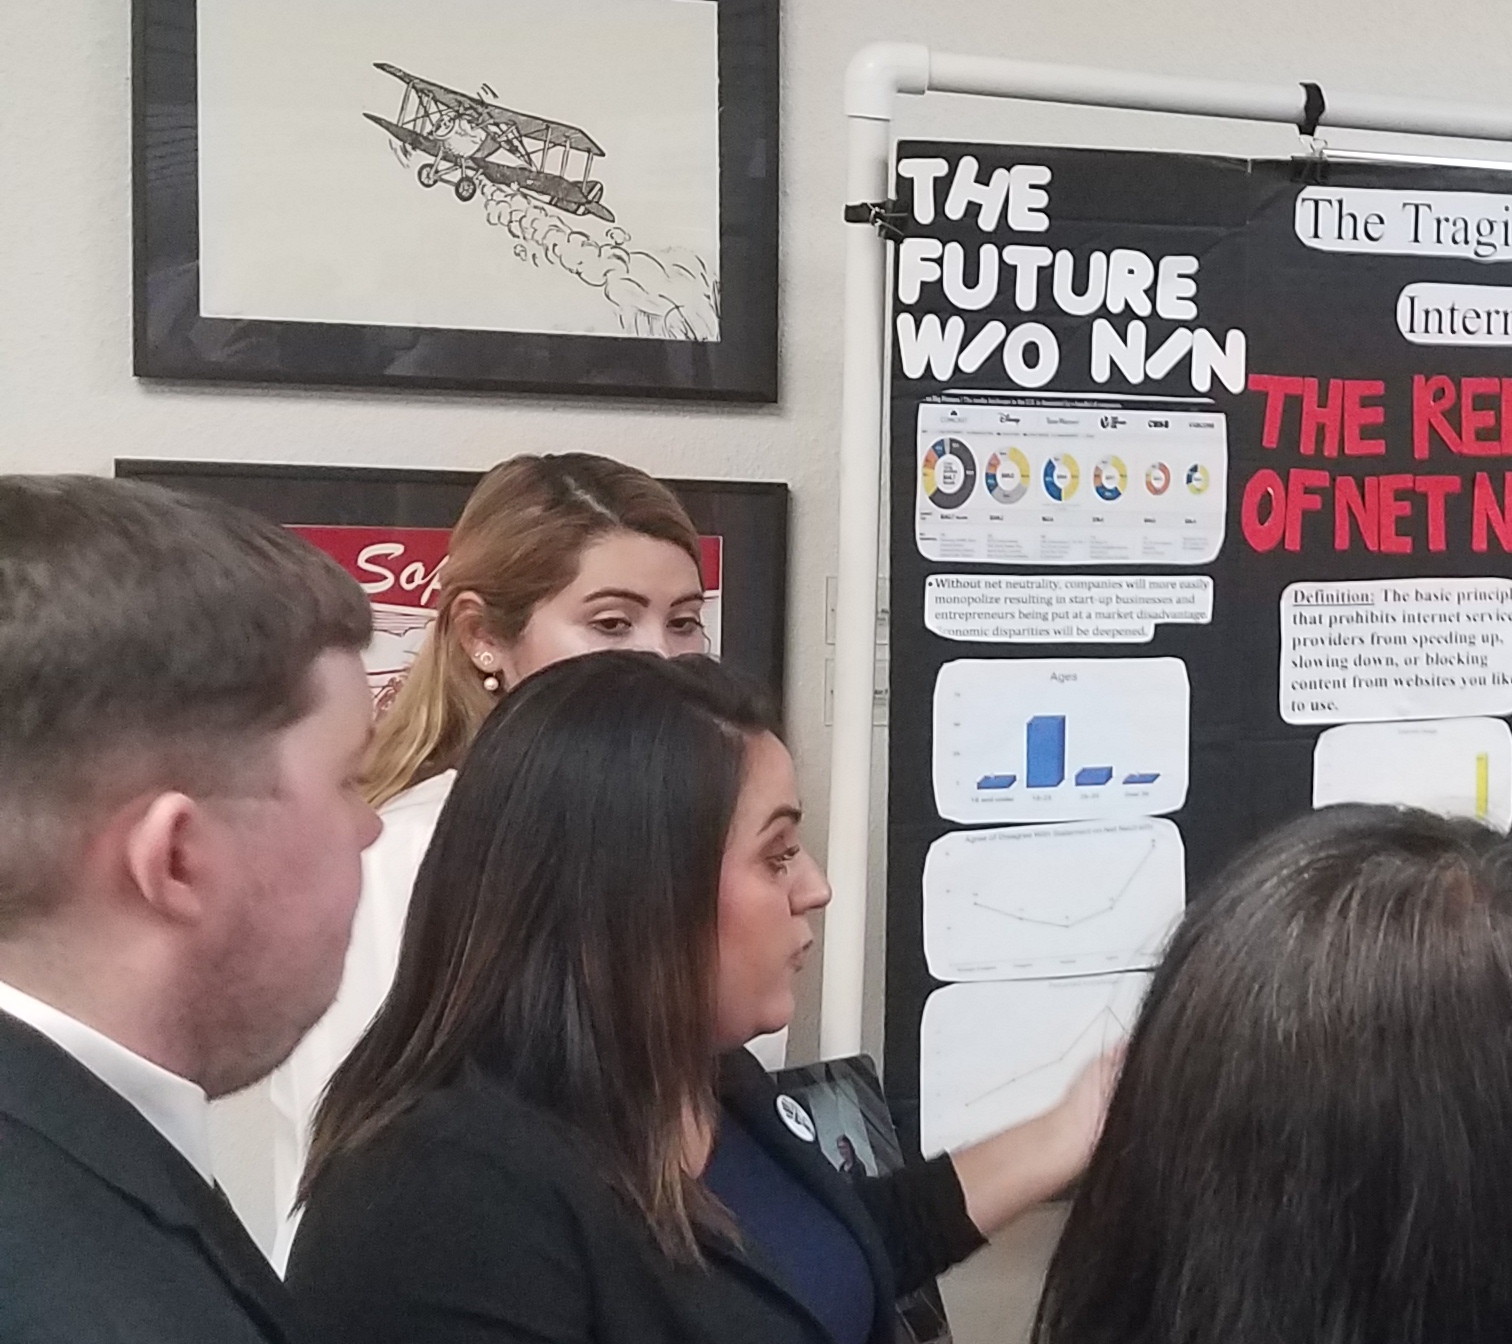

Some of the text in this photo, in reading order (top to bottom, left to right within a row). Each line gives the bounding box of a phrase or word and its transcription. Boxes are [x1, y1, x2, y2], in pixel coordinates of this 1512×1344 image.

[898, 156, 1052, 232] THE
[1302, 197, 1385, 243] The
[897, 238, 1199, 320] FUTURE
[896, 313, 1246, 393] W/O N/N
[1248, 374, 1386, 457] THE
[1241, 469, 1330, 553] OF
[1333, 472, 1463, 553] NET
[935, 578, 1209, 591] Without net neutrality, companies will more easily
[935, 594, 1195, 607] monopolize resulting in start-up businesses and
[1293, 589, 1374, 605] Definition:
[1381, 589, 1409, 603] The
[1415, 588, 1451, 602] basic
[935, 610, 1015, 622] entrepreneurs
[1018, 609, 1048, 622] being
[1052, 610, 1069, 622] put
[1072, 610, 1083, 620] at
[1095, 609, 1134, 619] market
[1292, 612, 1323, 625] that
[1328, 611, 1397, 627] prohibits
[1402, 610, 1461, 623] internet
[992, 626, 1050, 638] disparities
[1053, 626, 1073, 636] will
[1077, 626, 1088, 636] be
[1091, 626, 1147, 638] deepened.
[1292, 631, 1504, 650] providers from speeding up,
[1291, 652, 1488, 671] slowing down, or blocking
[1050, 671, 1078, 683] Ages
[1291, 677, 1347, 691] content
[1352, 675, 1388, 688] from
[1393, 674, 1456, 688] websites
[1460, 676, 1486, 691] you
[1291, 699, 1339, 711] to use.
